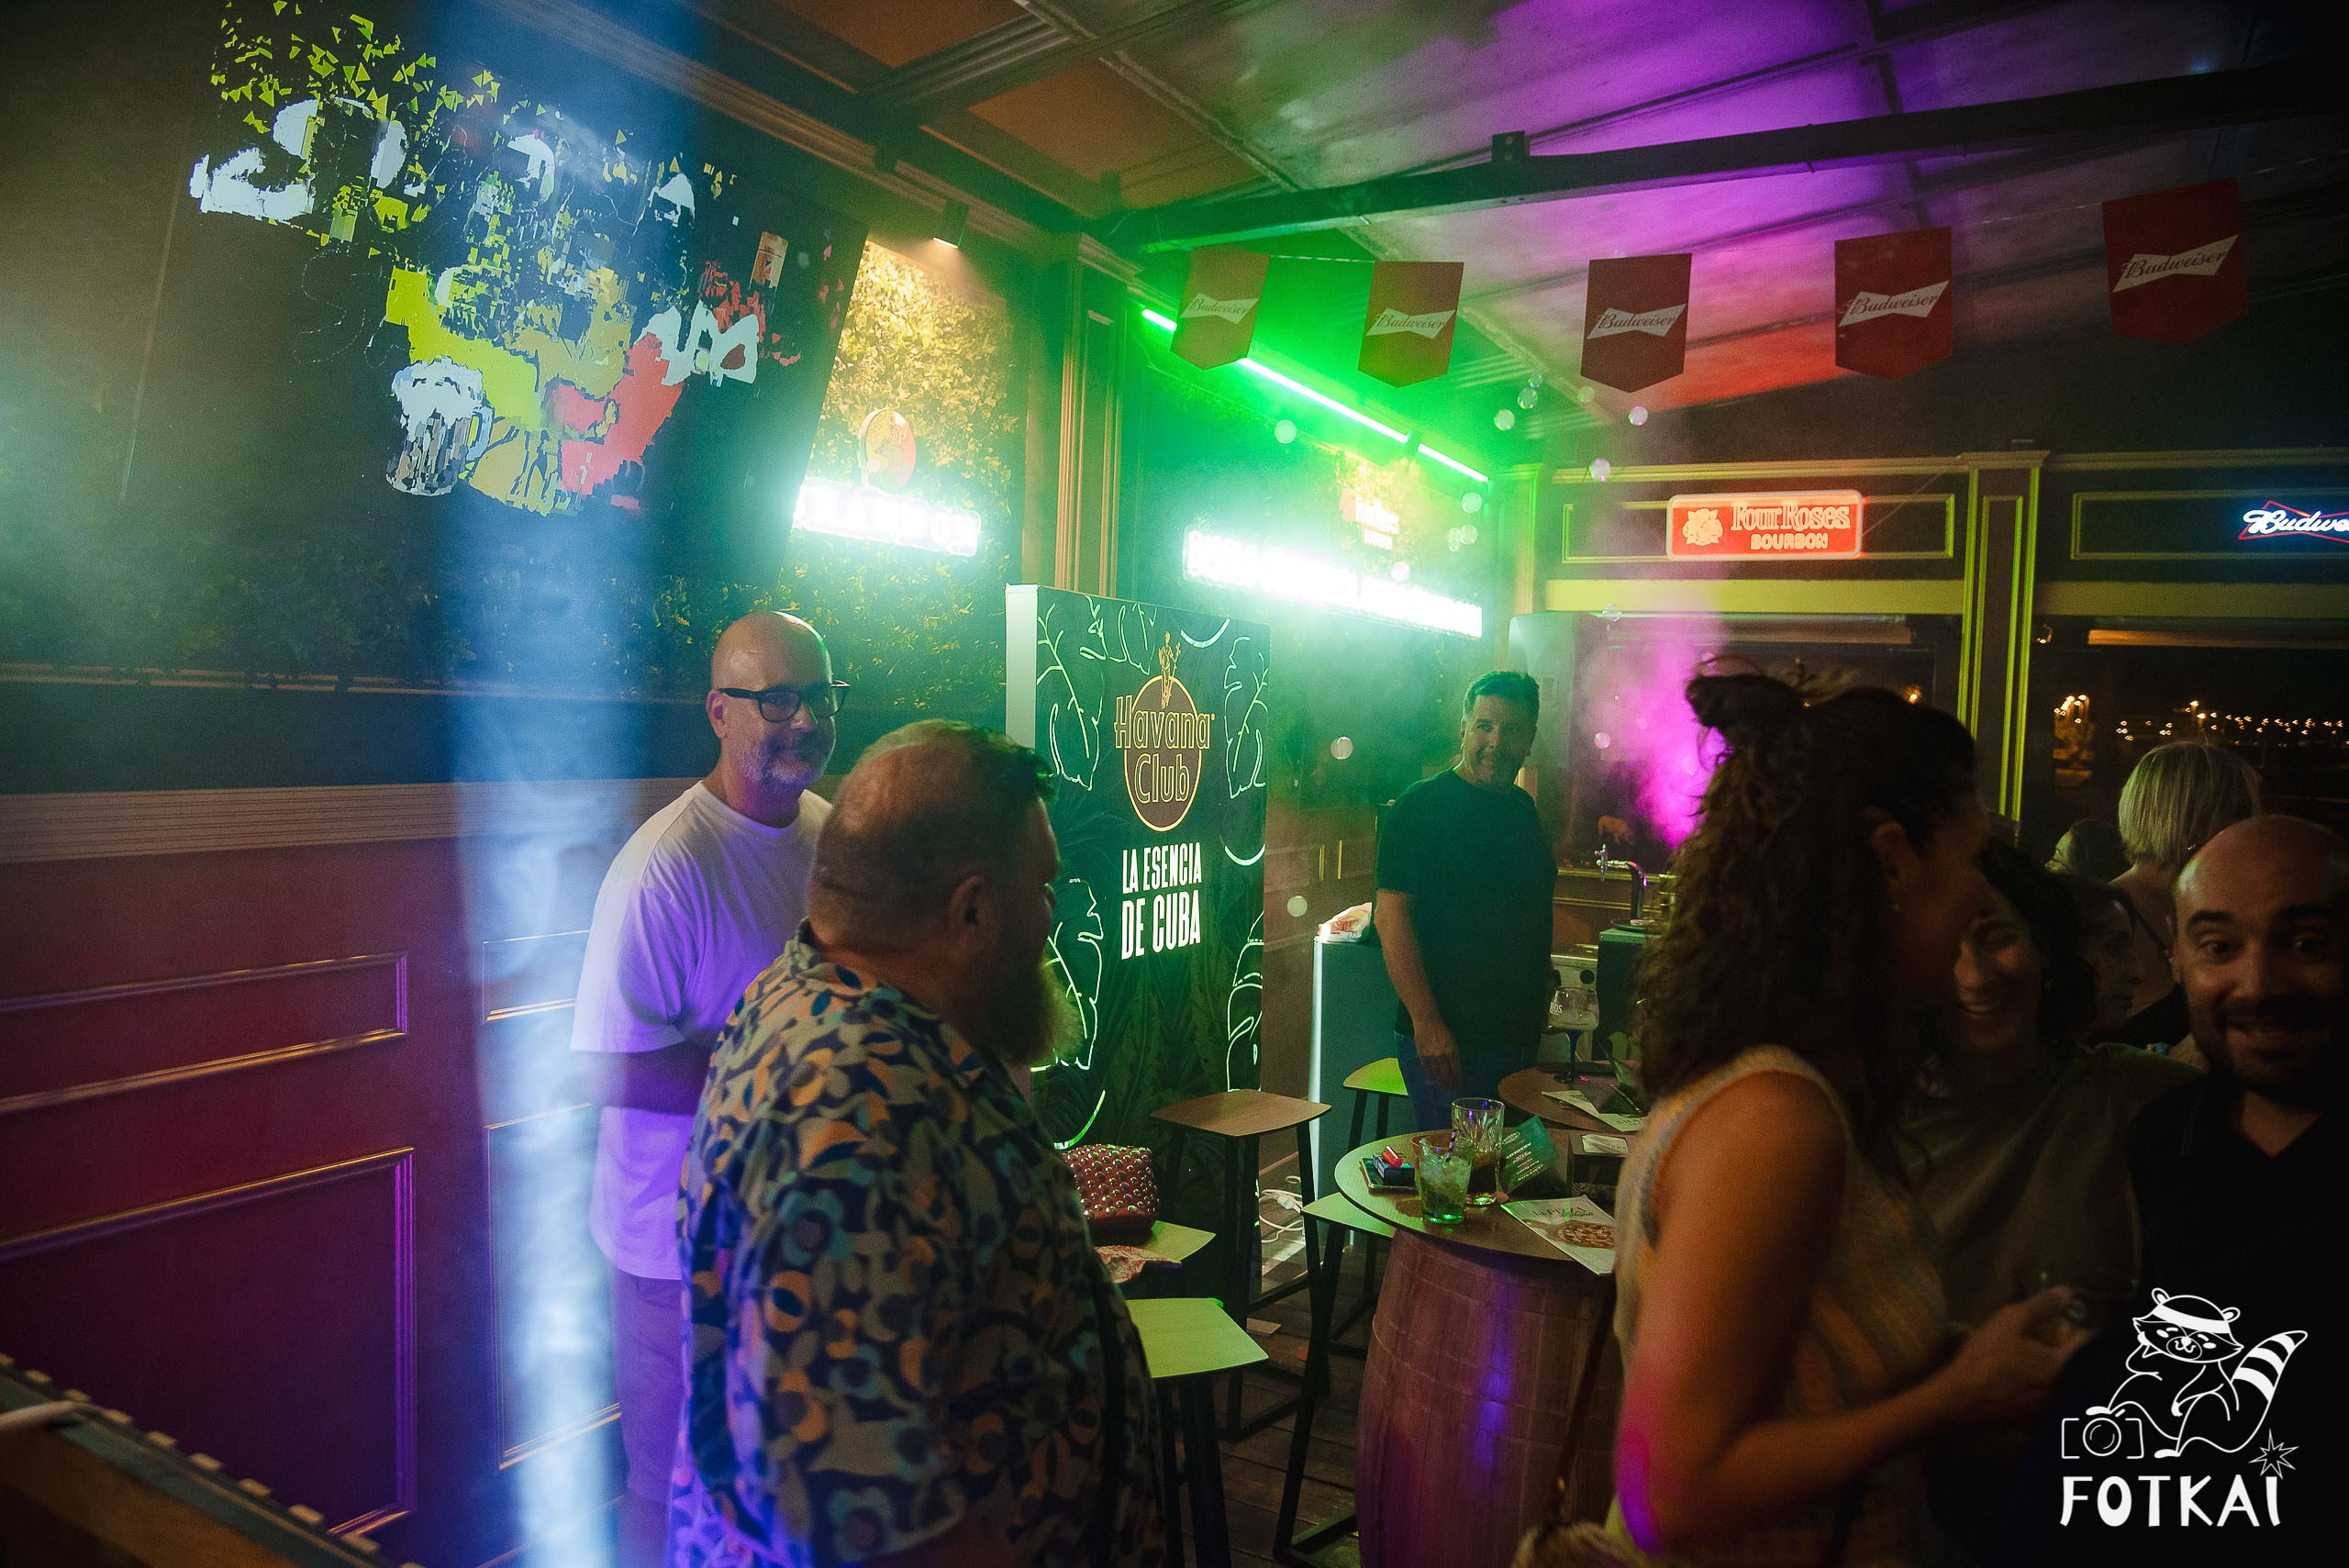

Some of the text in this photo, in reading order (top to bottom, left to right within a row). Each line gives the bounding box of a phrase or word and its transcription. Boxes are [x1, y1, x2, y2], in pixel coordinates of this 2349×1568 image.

[2121, 250, 2226, 279] Budweiser
[1187, 298, 1249, 315] Budweiser
[1845, 295, 1939, 315] Budweiser
[1376, 313, 1445, 329] Budweiser
[1596, 313, 1676, 329] Budweiser
[1731, 500, 1852, 532] Four Roses
[1750, 532, 1829, 550] BOURBON
[1114, 695, 1210, 749] Havana
[1134, 752, 1190, 804] Club
[1122, 841, 1202, 895] LA ESENCIA
[1120, 889, 1201, 960] DE CUBA
